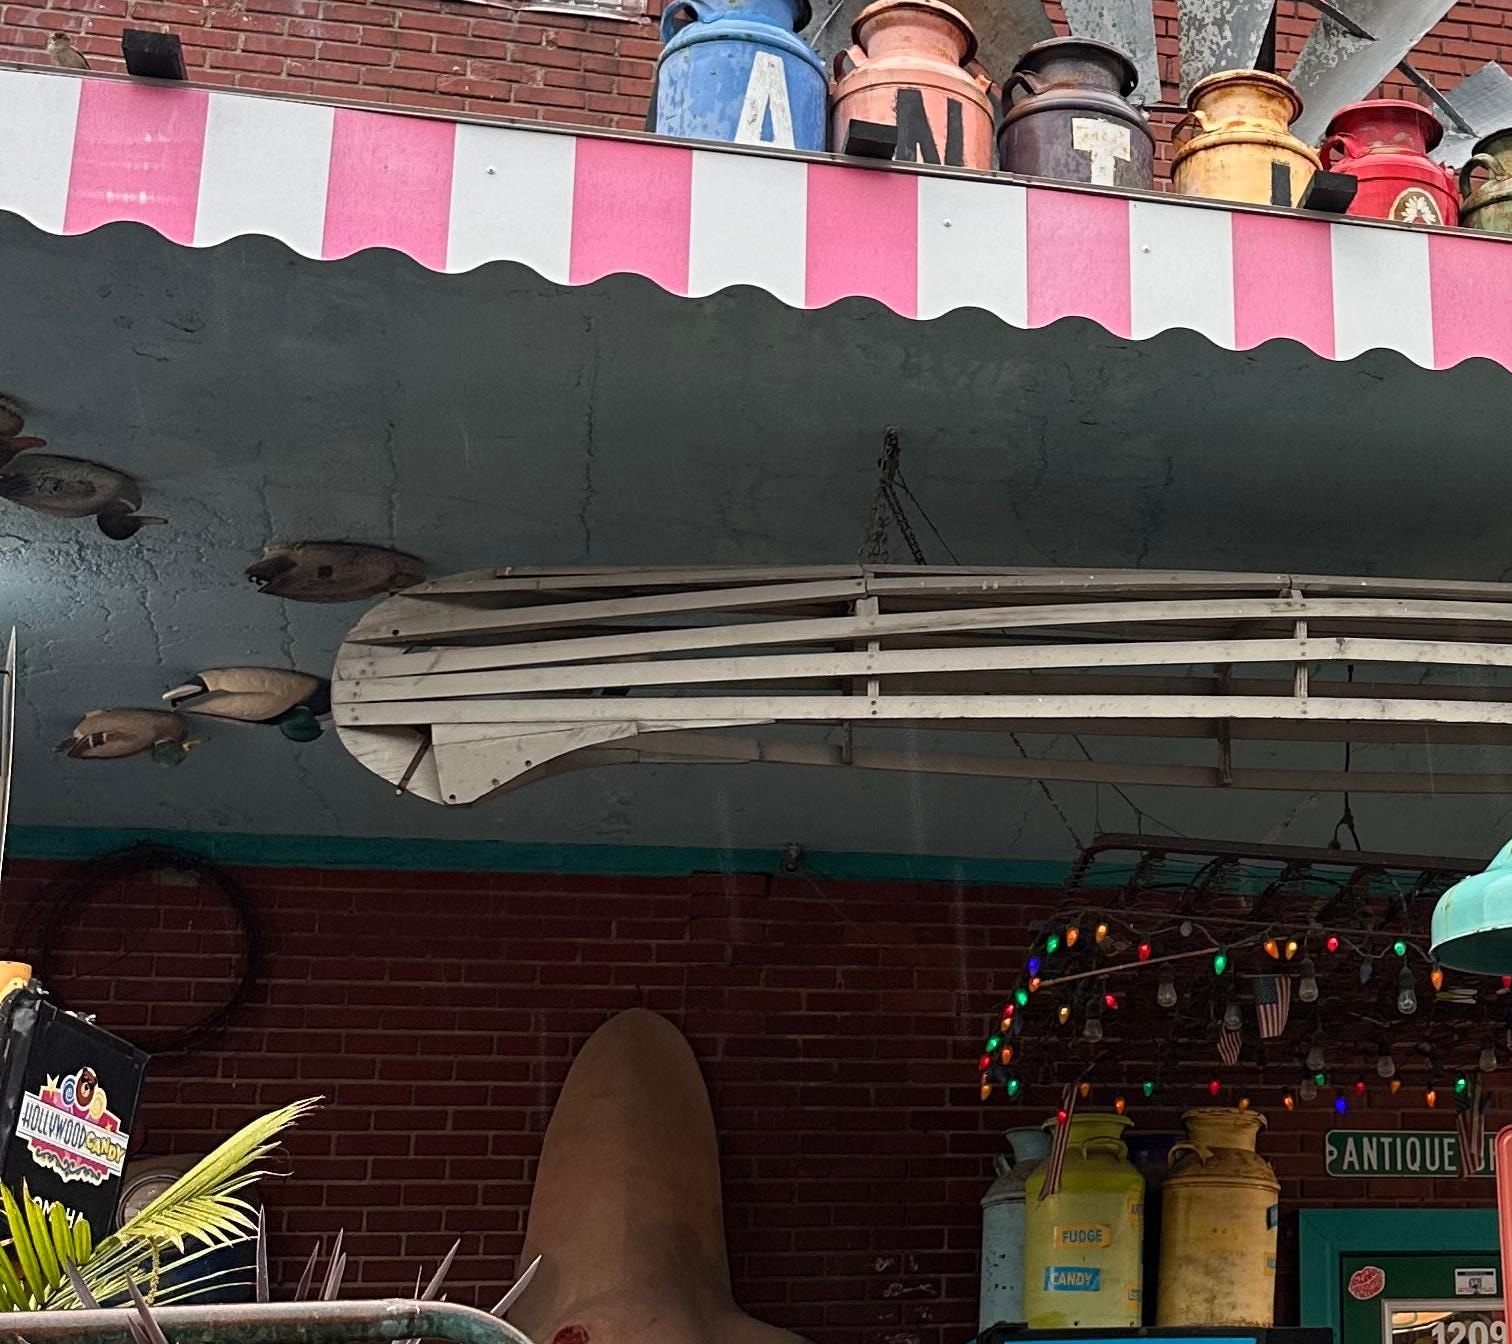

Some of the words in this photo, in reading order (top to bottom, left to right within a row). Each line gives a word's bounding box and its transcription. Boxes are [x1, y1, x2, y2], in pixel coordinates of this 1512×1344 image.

[22, 1101, 87, 1149] HOLLYWOOD
[84, 1131, 126, 1164] CANDY
[1342, 1137, 1457, 1171] ANTIQUE
[1062, 1229, 1103, 1244] FUDGE
[1050, 1272, 1093, 1287] CANDY
